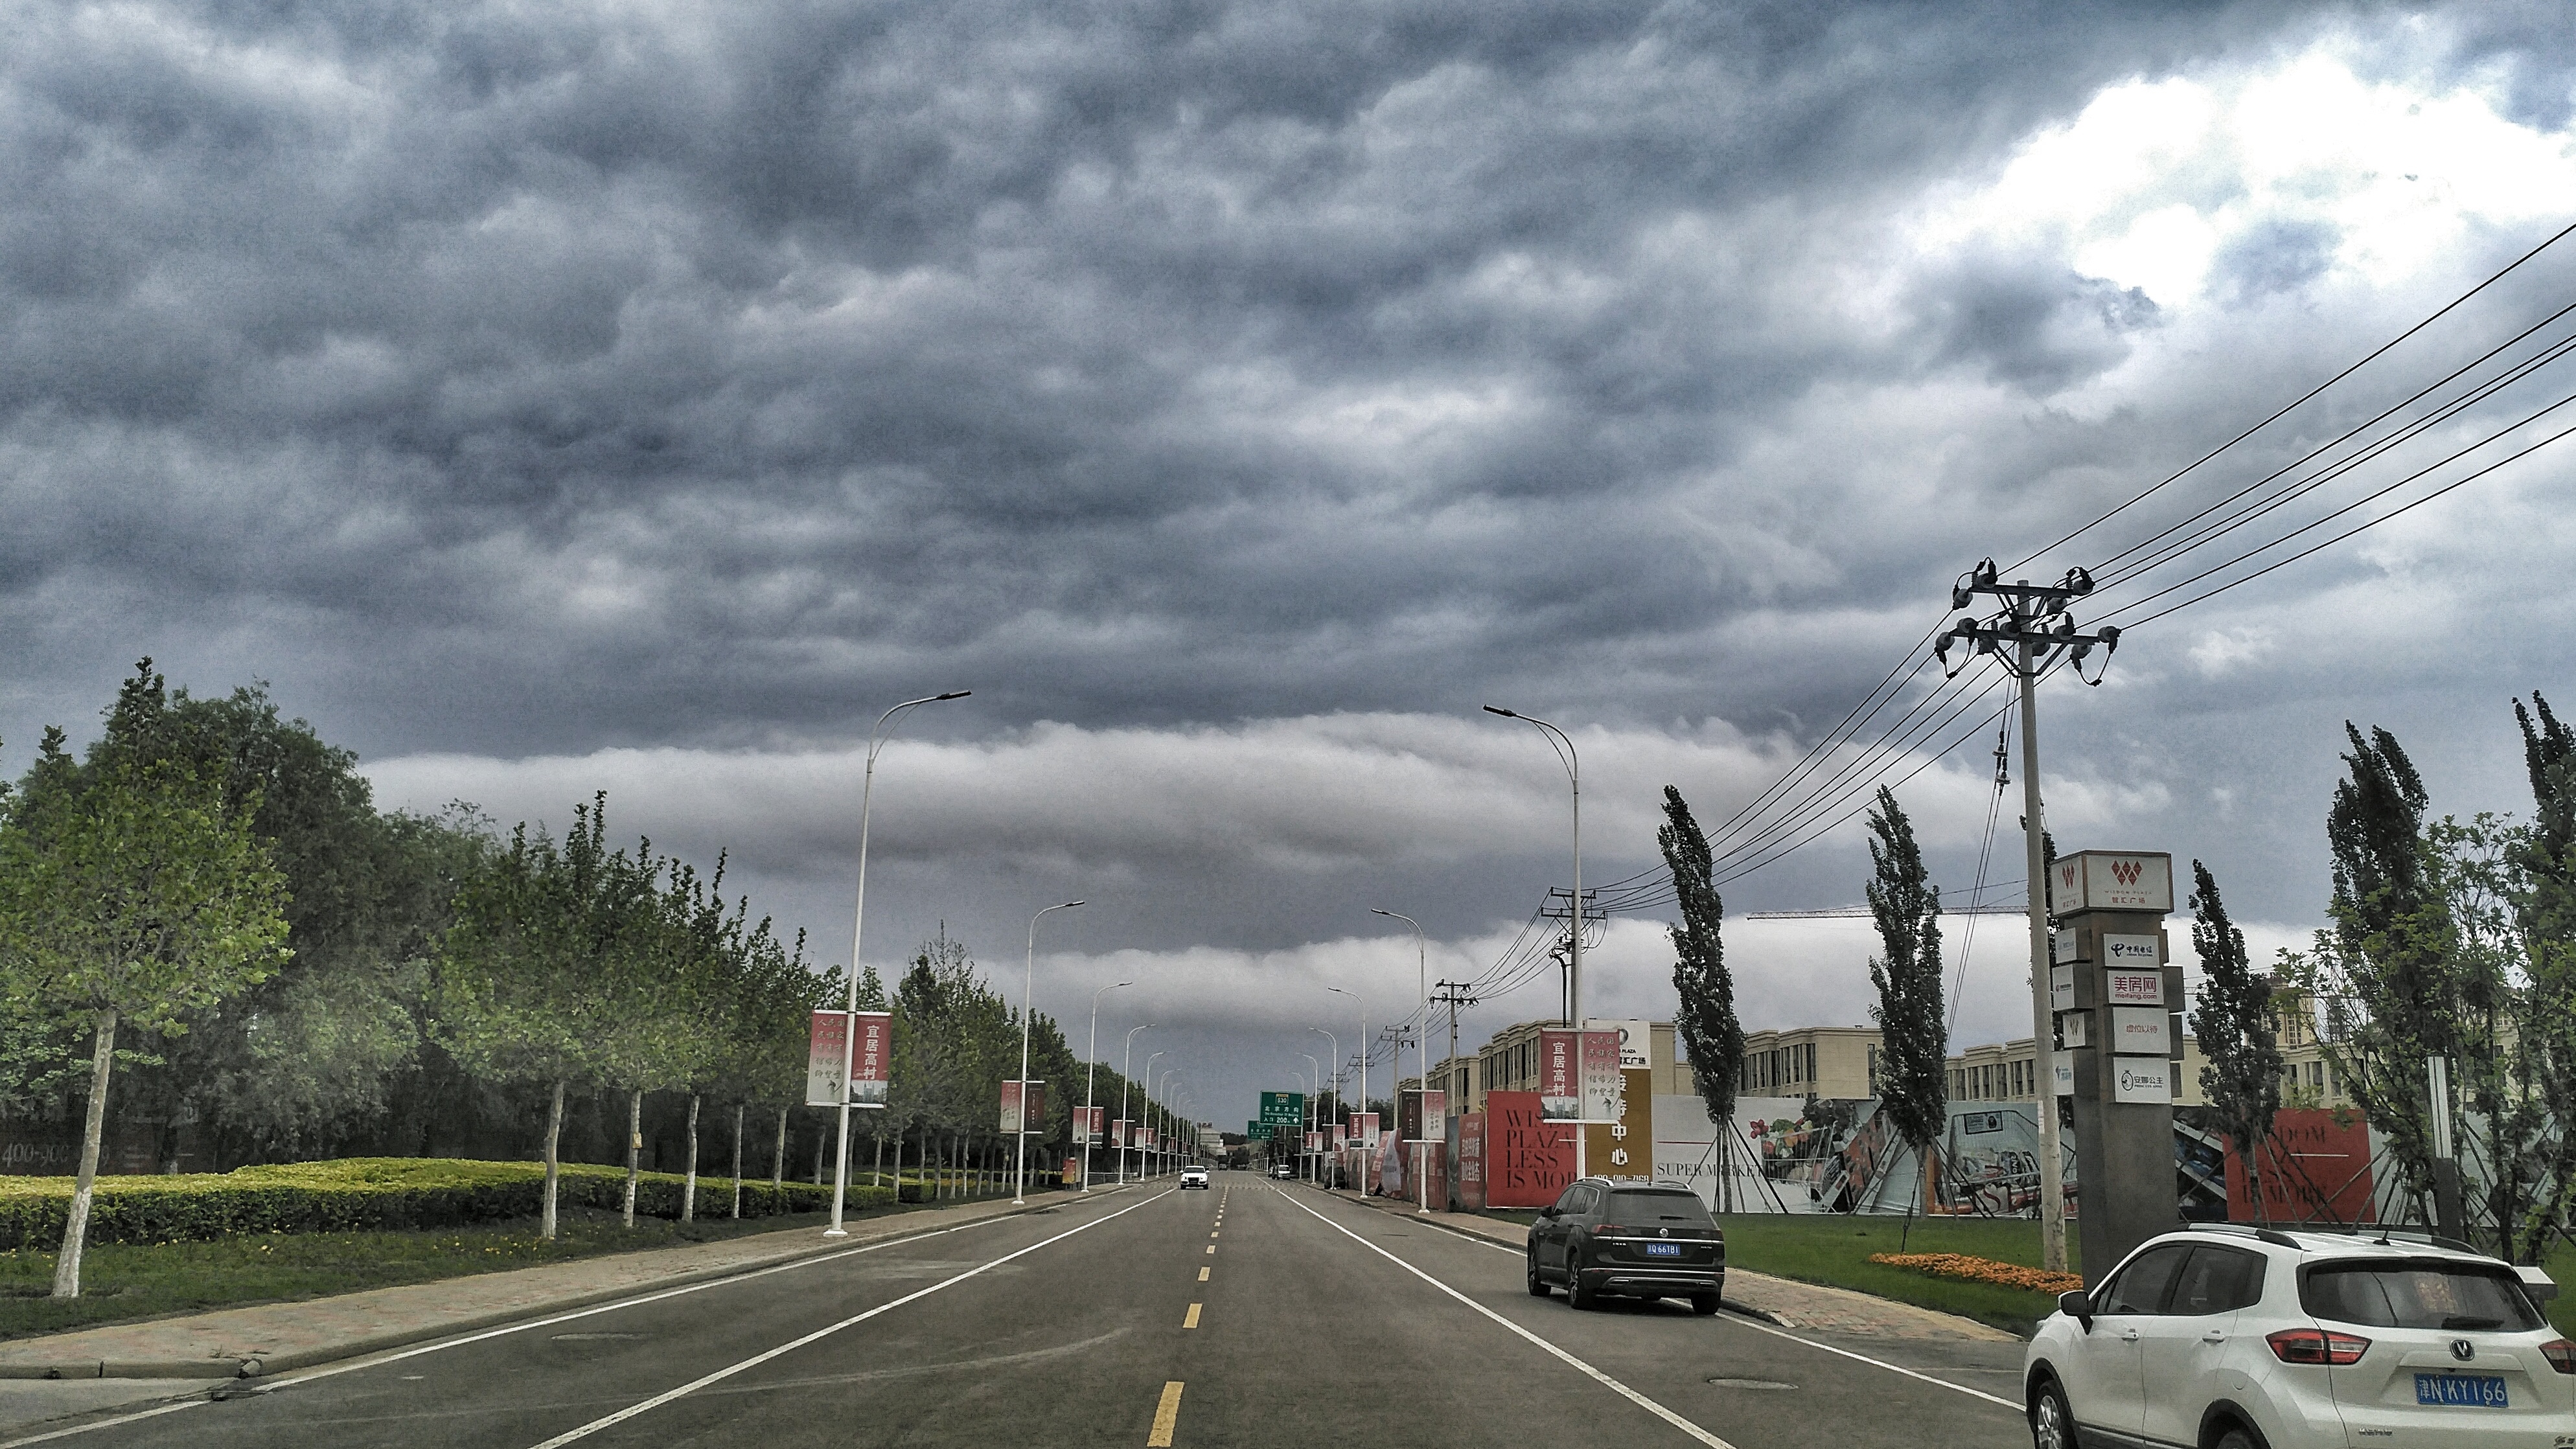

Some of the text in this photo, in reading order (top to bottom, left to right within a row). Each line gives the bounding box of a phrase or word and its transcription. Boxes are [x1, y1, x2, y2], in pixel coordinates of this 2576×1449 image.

[2114, 976, 2157, 992] 美房网
[2126, 1024, 2158, 1033] 虚位以待
[864, 1025, 880, 1080] 宜居高村
[1552, 1042, 1566, 1096] 宜居高村
[1506, 1149, 1559, 1169] LESS
[1506, 1169, 1577, 1190] IS MOR
[1657, 1163, 1763, 1178] SUPER MRKET
